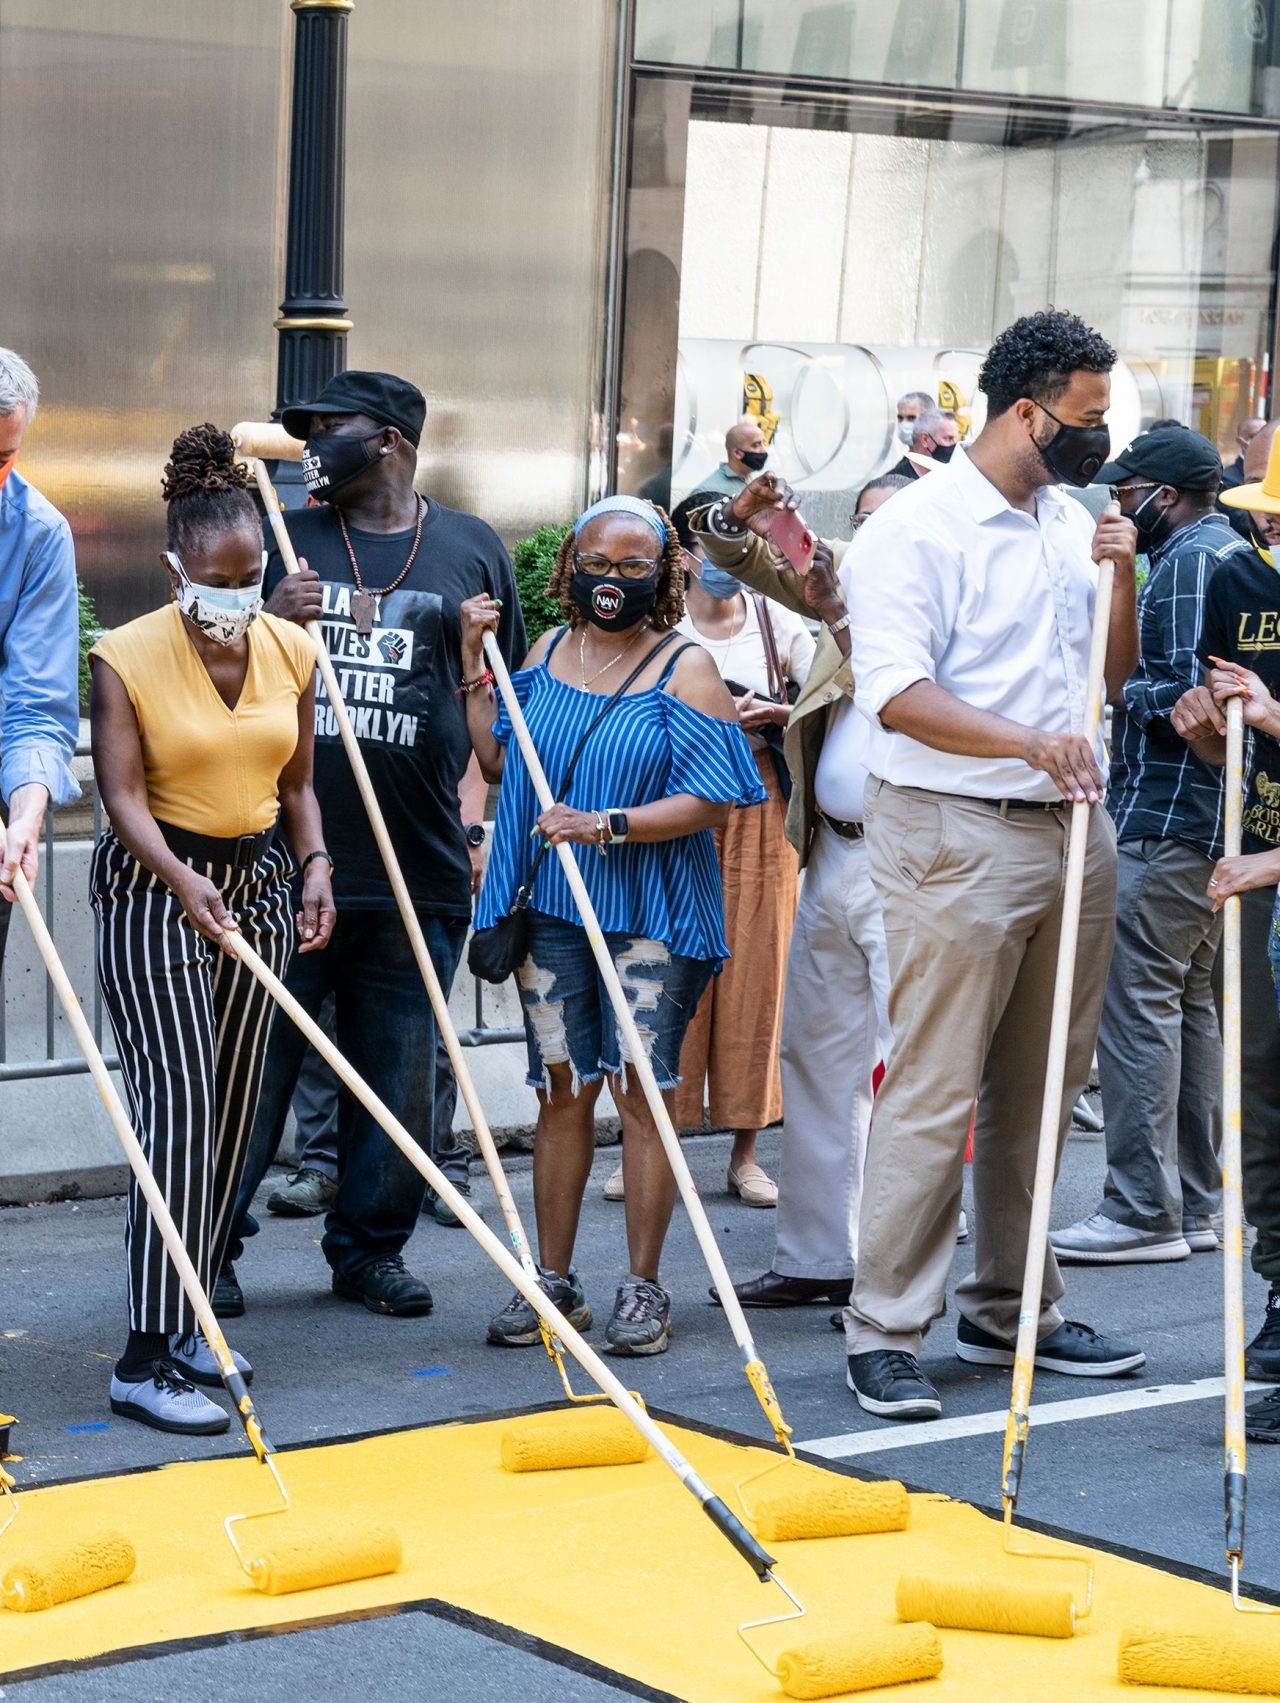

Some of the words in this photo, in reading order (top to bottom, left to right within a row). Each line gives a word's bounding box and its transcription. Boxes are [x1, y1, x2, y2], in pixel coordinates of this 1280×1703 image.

[596, 594, 619, 609] NAN
[321, 625, 371, 658] IVES
[1238, 611, 1280, 642] LE
[315, 668, 395, 704] TTER
